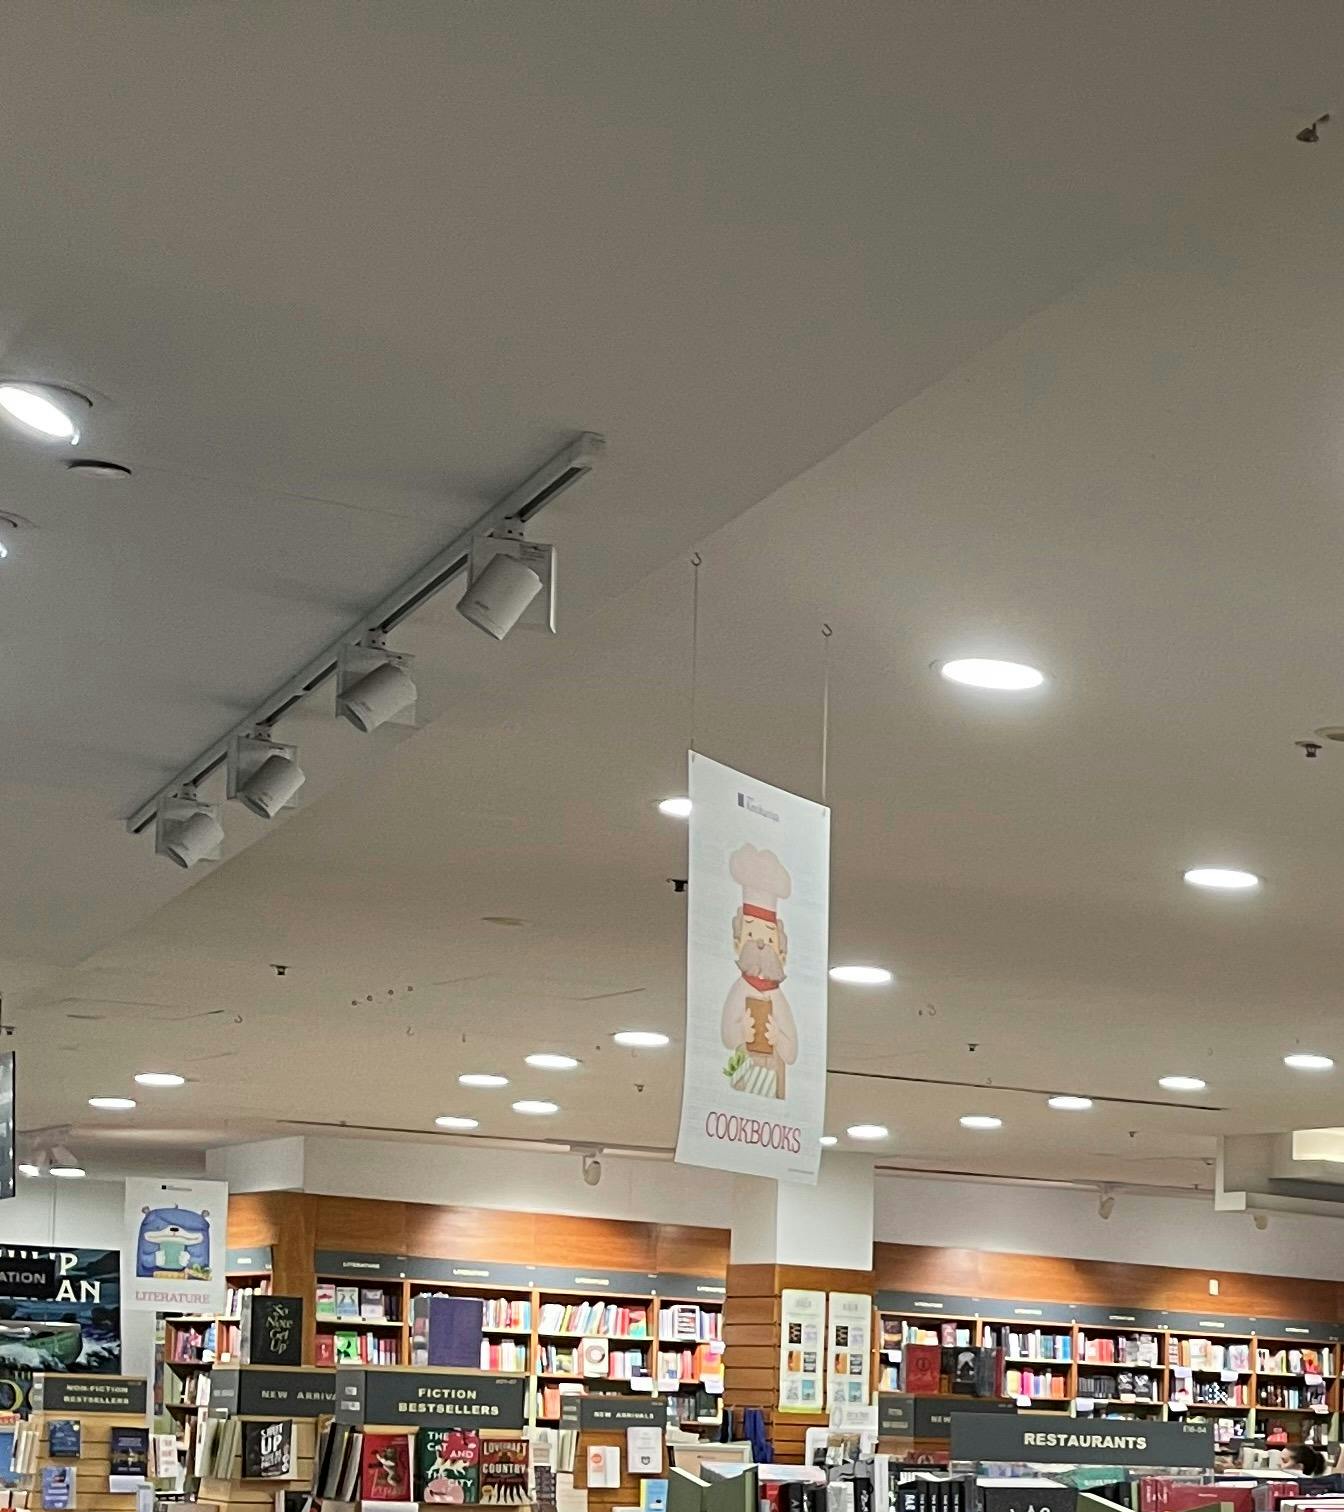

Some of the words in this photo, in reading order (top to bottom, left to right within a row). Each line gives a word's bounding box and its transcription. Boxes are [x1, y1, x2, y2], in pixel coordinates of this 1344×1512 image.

[706, 1111, 801, 1154] COOKBOOKS
[136, 1291, 209, 1304] LITERATURE
[64, 1395, 129, 1404] BESTSELLERS
[418, 1388, 477, 1399] FICTION
[398, 1402, 499, 1416] BESTSELLERS
[616, 1411, 654, 1419] ARRIVALS
[428, 1432, 449, 1441] THE
[1024, 1432, 1147, 1449] RESTAURANTS
[260, 1436, 282, 1454] UP
[482, 1464, 526, 1474] COUNTRY
